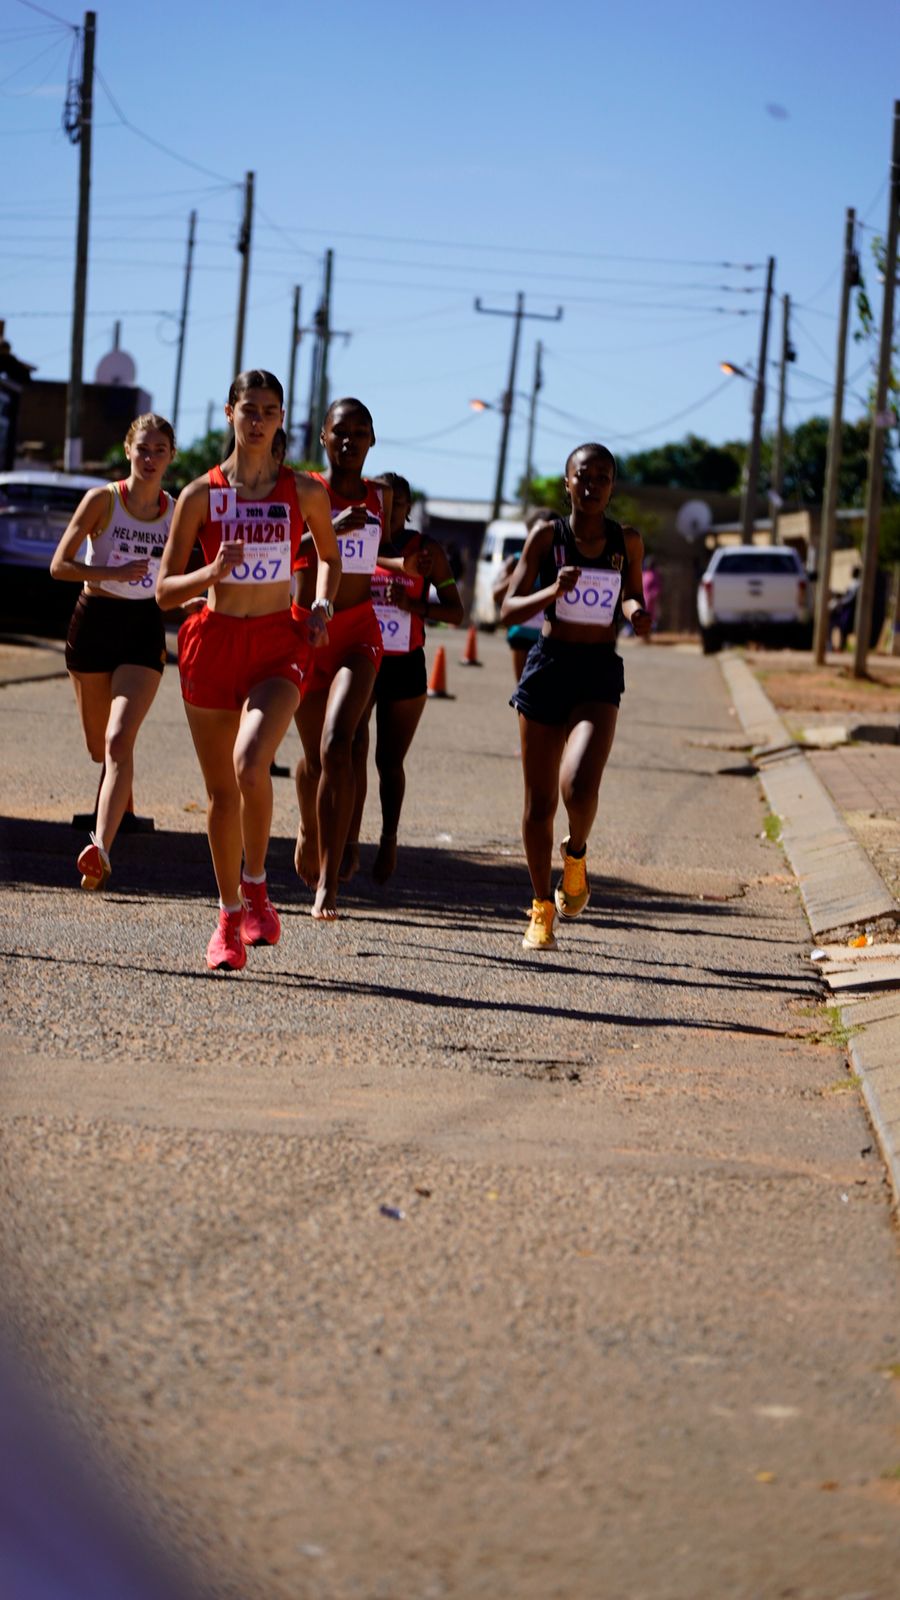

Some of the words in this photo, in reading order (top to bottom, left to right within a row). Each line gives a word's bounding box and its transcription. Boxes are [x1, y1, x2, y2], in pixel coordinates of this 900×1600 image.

[215, 494, 228, 515] J
[232, 560, 282, 580] 067
[563, 587, 614, 608] 002
